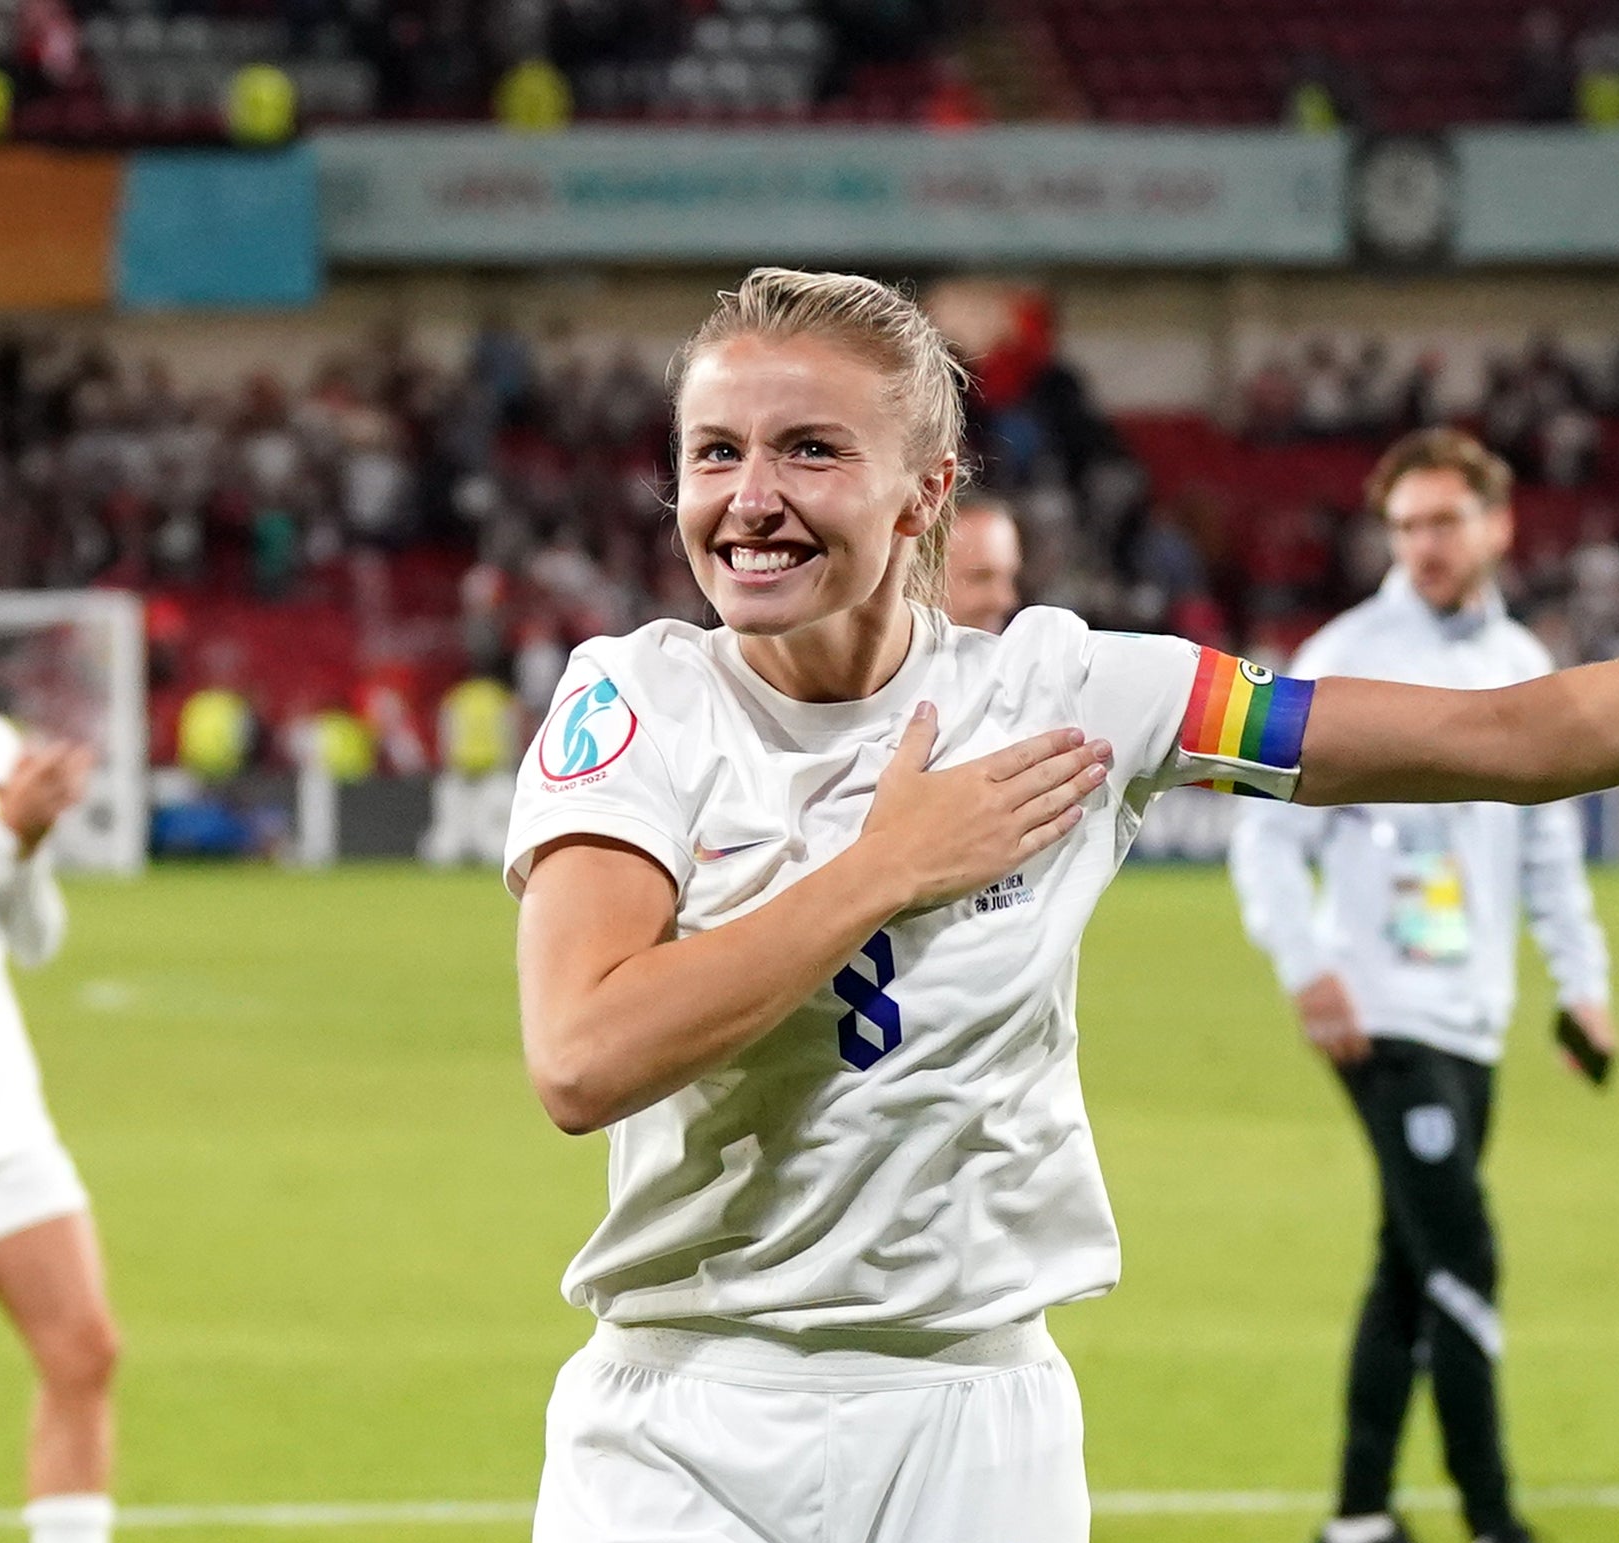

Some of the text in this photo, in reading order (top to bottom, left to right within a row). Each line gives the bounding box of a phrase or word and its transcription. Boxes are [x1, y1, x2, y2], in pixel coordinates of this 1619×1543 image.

[541, 771, 607, 793] ENGLAND 2022
[975, 897, 988, 912] 26
[991, 893, 1013, 911] JULY
[832, 928, 903, 1072] 8
